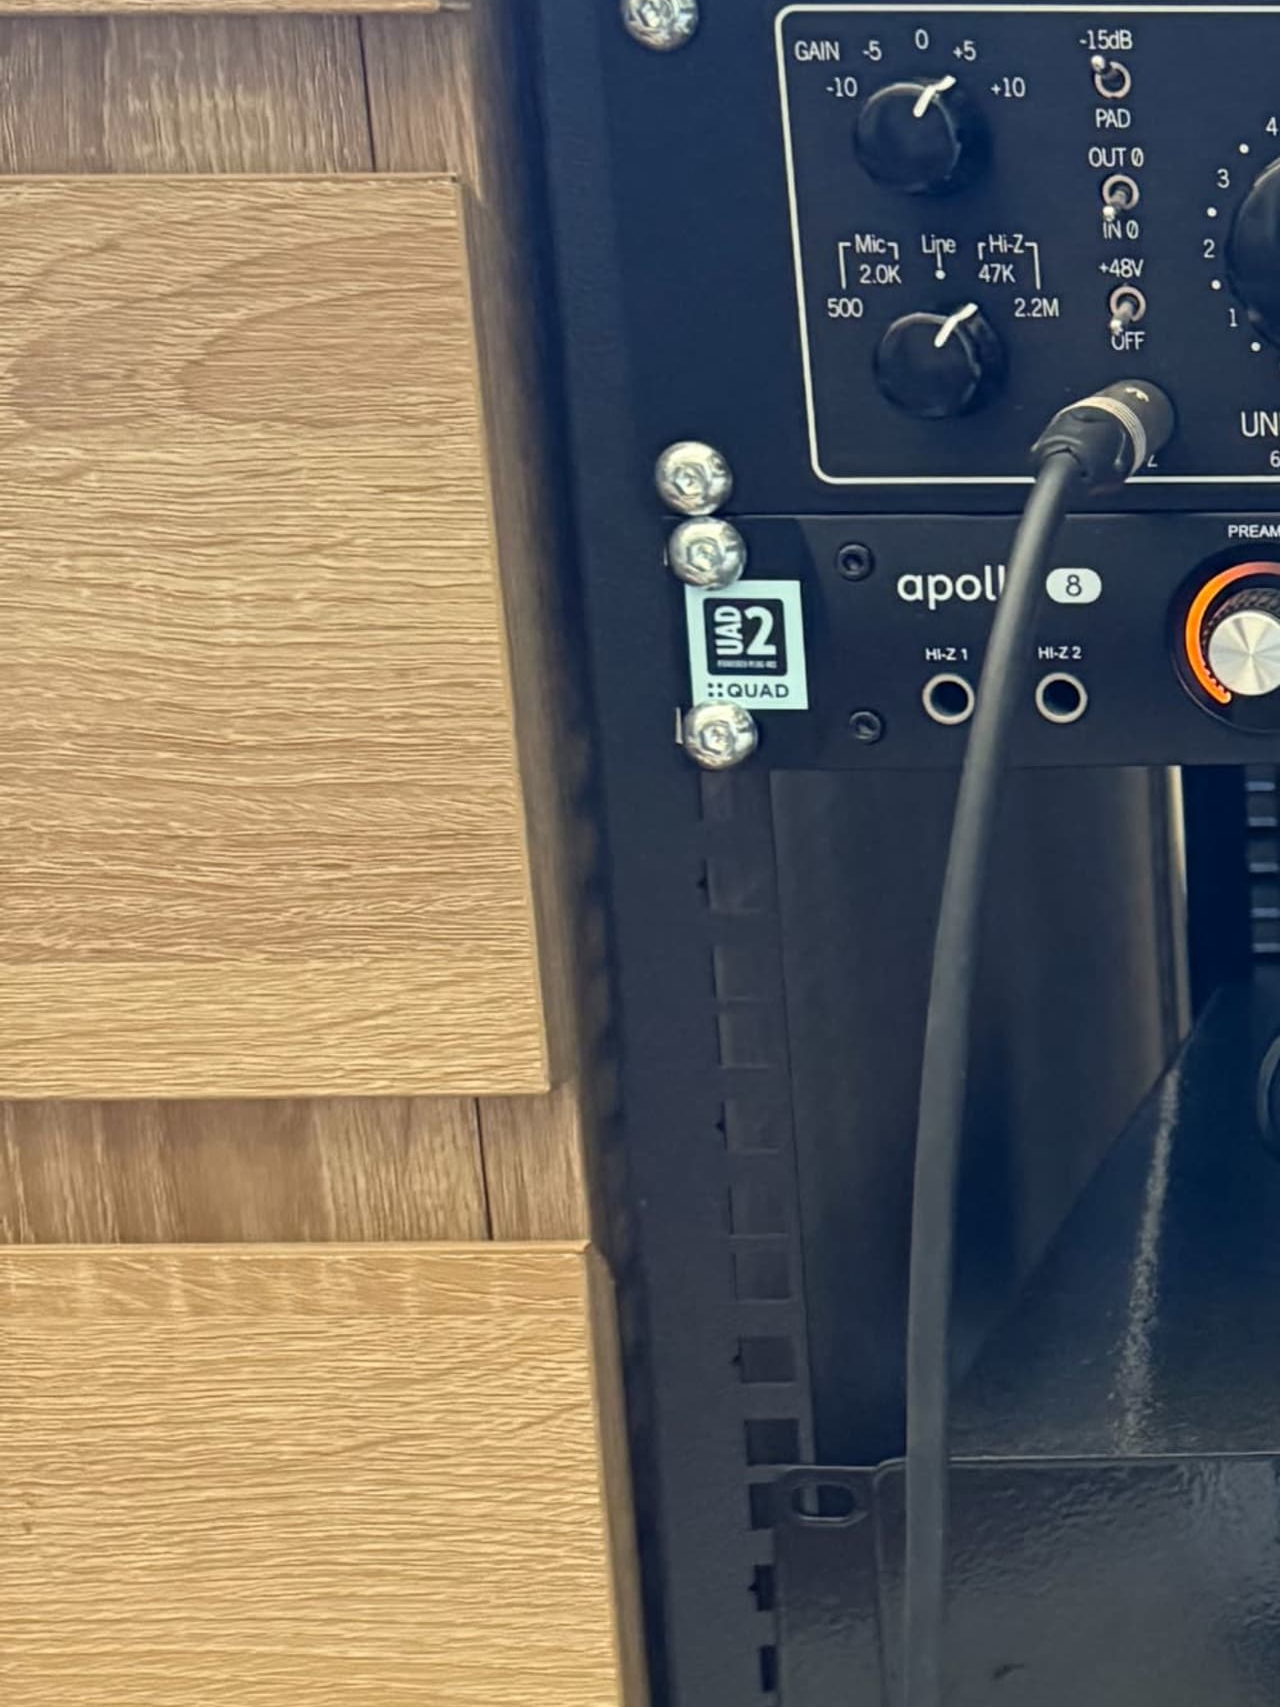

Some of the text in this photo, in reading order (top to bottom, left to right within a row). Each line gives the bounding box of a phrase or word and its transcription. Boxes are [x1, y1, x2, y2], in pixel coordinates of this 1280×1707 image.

[914, 28, 929, 50] 0
[1079, 29, 1133, 50] -15dB
[794, 40, 840, 62] GAIN
[863, 39, 882, 61] -5
[953, 39, 977, 61] +5
[826, 76, 858, 98] -10
[990, 76, 1026, 98] +10
[1095, 108, 1131, 129] PAD
[1265, 116, 1278, 136] 4
[1088, 146, 1127, 168] OUT
[1217, 168, 1230, 189] 3
[1104, 222, 1123, 239] IN
[855, 237, 886, 253] Mic
[922, 237, 956, 254] Line
[989, 236, 1025, 253] Hi-Z
[1203, 238, 1215, 259] 2
[860, 265, 901, 283] 2.0K
[978, 263, 1016, 283] 47K
[1099, 257, 1144, 279] +48V
[827, 297, 864, 318] 500
[1014, 297, 1060, 318] 2.2M
[1229, 307, 1238, 328] 1
[1112, 333, 1145, 350] OFF
[897, 564, 1083, 611] apoll 8
[714, 606, 776, 655] UAD 2
[925, 647, 968, 661] HI-Z 1
[1037, 645, 1082, 660] HI-Z 2
[728, 684, 789, 698] QUAD
